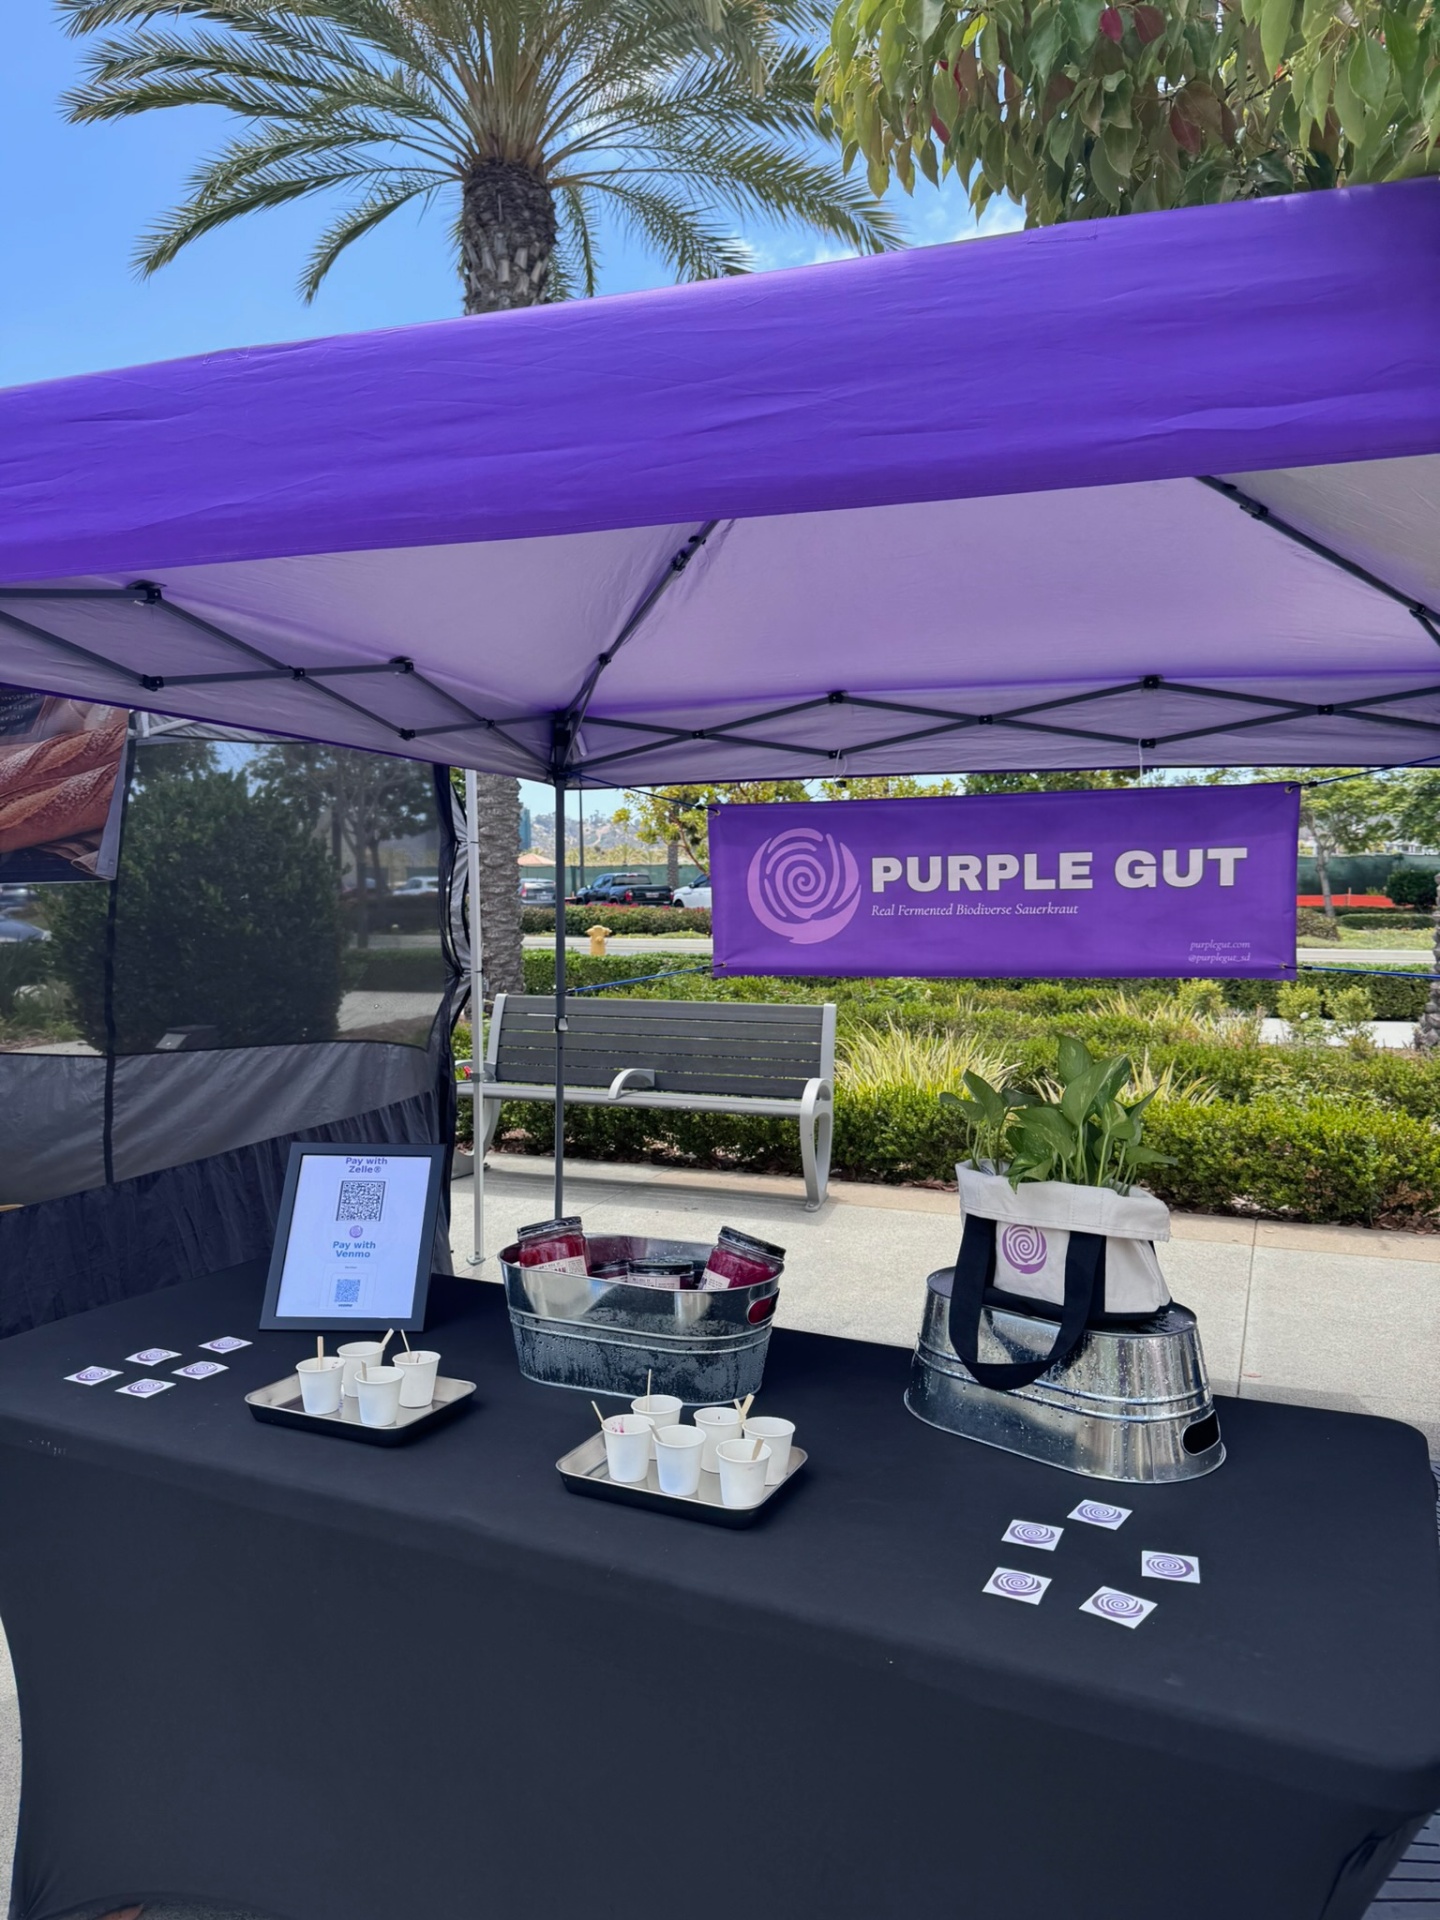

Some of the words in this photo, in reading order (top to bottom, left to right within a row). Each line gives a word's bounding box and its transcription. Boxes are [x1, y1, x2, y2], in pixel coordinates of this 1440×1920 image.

[871, 851, 1093, 893] PURPLE
[1114, 847, 1248, 889] GUT
[871, 904, 895, 916] Real
[898, 903, 953, 916] Fermented
[956, 903, 1012, 916] Biodiverse
[1015, 902, 1079, 915] Sauerkraut
[1190, 939, 1250, 951] purplegut.com
[1188, 952, 1251, 964] @purplegut_sd
[345, 1157, 364, 1166] Pay
[366, 1157, 388, 1165] with
[332, 1240, 351, 1250] Pay
[353, 1241, 376, 1249] with
[335, 1250, 371, 1258] Venmo
